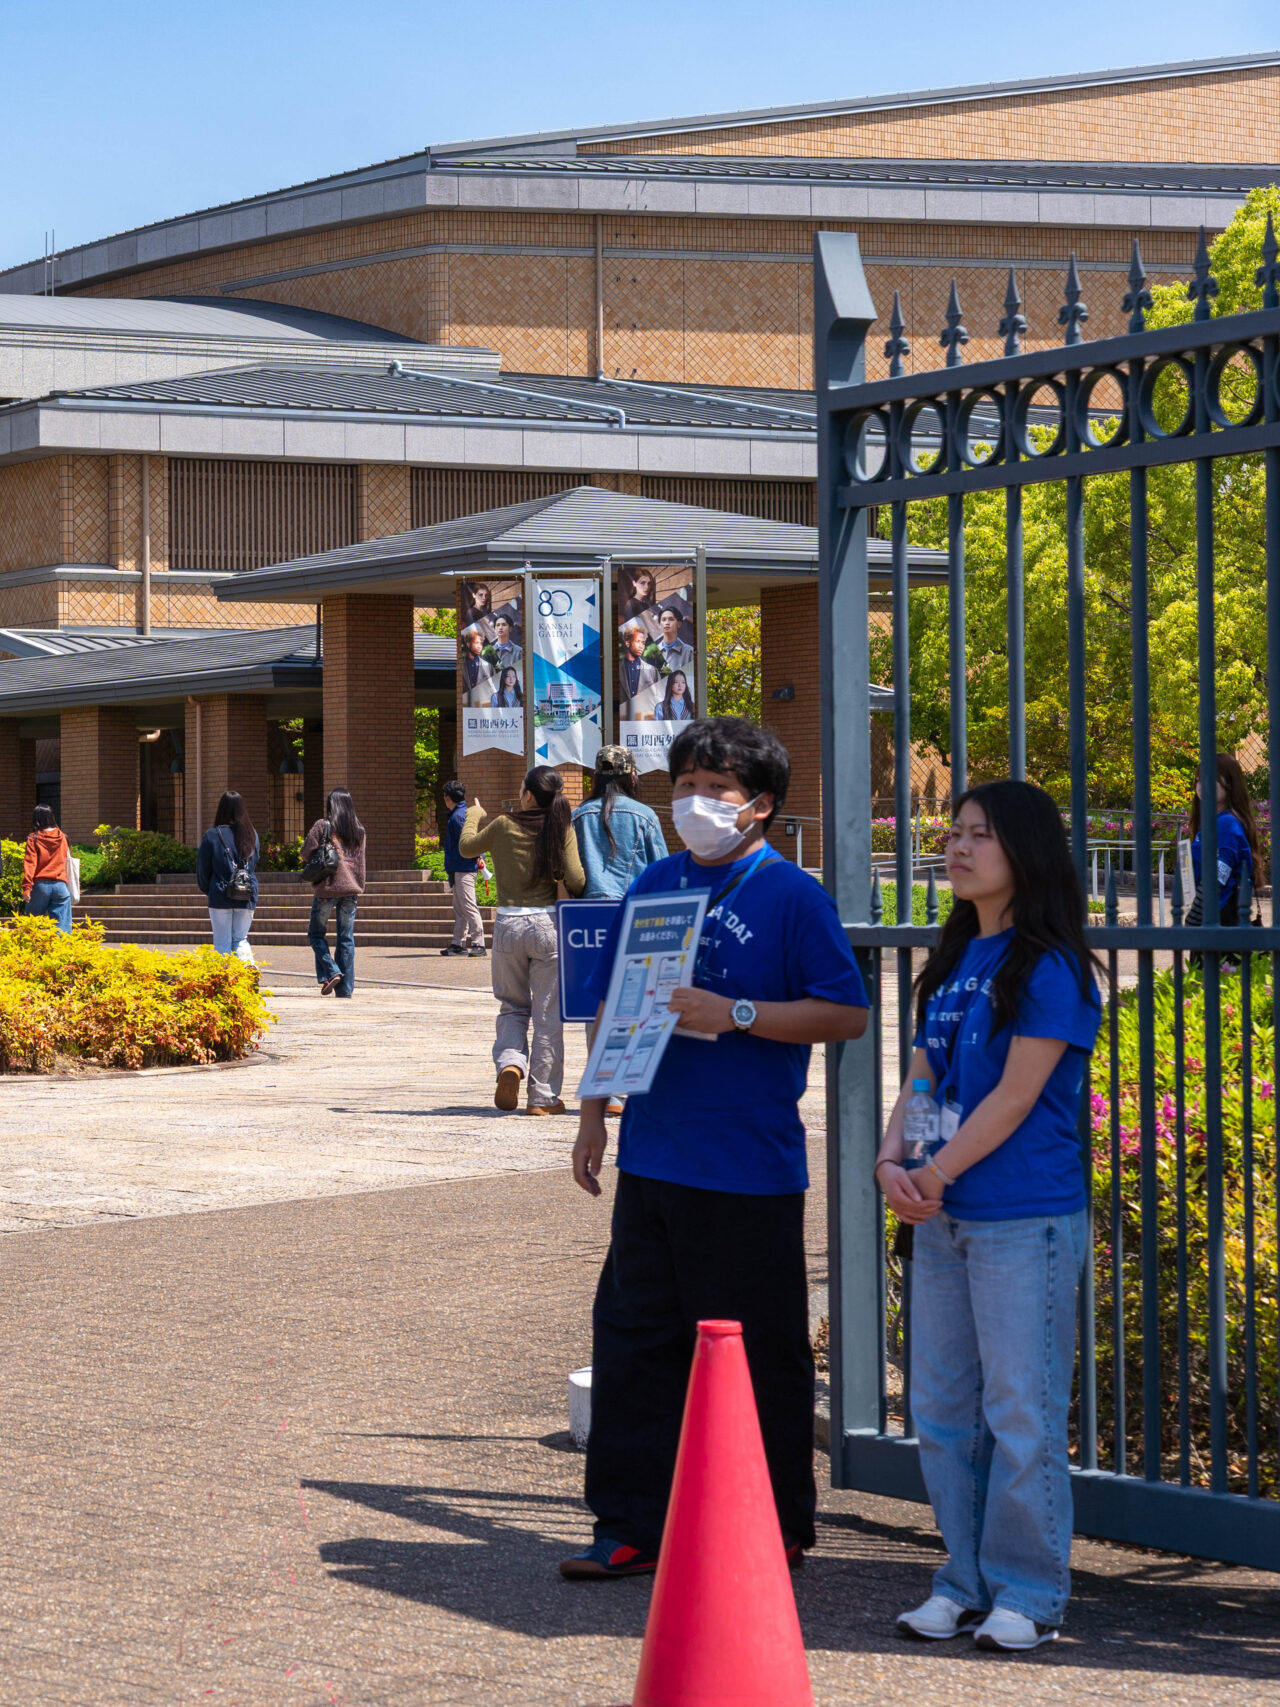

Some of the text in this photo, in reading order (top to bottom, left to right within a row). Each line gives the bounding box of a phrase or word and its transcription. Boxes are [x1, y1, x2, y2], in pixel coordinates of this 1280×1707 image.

[538, 630, 573, 638] GAIDAI
[480, 718, 519, 729] 関西外大
